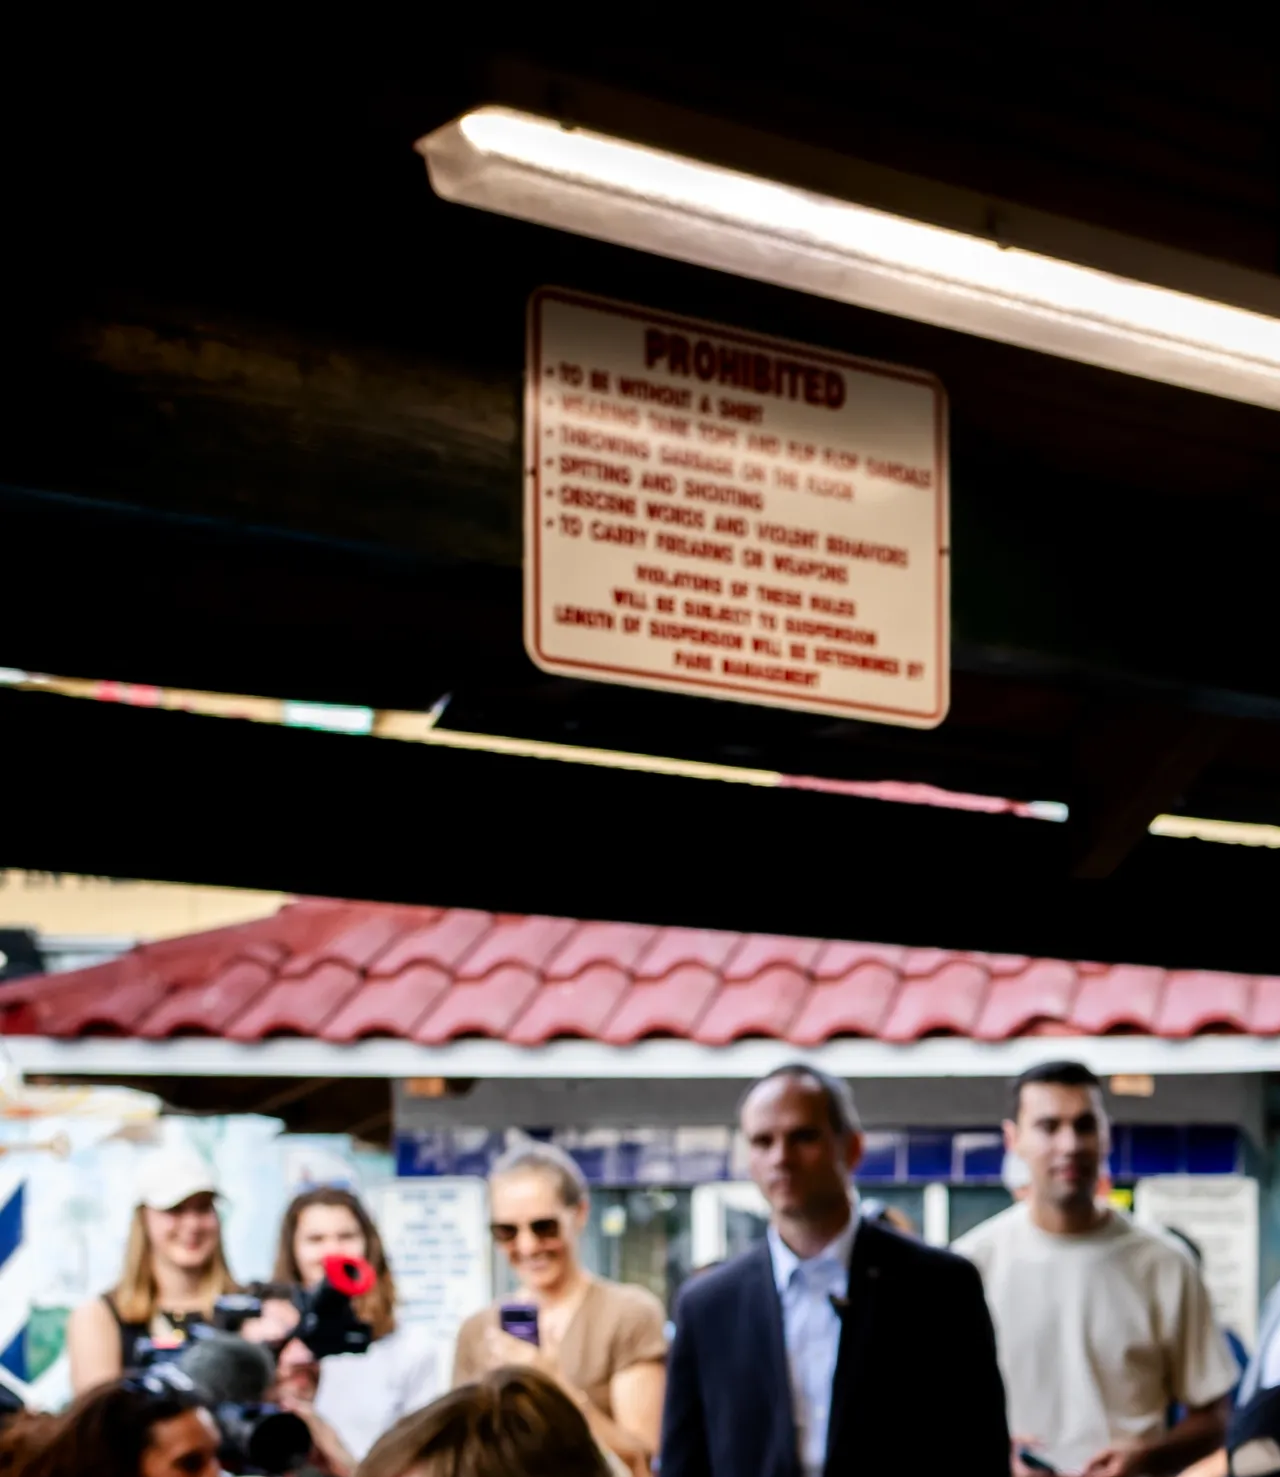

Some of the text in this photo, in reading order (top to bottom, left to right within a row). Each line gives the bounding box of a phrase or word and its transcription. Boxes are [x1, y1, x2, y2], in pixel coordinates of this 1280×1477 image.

[559, 363, 581, 387] TO
[590, 370, 608, 392] BE
[619, 376, 690, 410] WITHOUT
[701, 394, 710, 414] A
[645, 329, 845, 411] PROHIBITED
[561, 426, 649, 461] THROWING
[560, 456, 630, 487] SPITTING
[640, 471, 675, 495] AND
[561, 484, 635, 517] OBSCENE
[646, 501, 703, 529] WORDS
[714, 513, 747, 537] AND
[758, 522, 817, 550] VIOLENT
[560, 515, 848, 585] TO CARRY FIREARMS OR WEAPONS
[636, 565, 721, 595] VIOLATORS
[730, 582, 747, 599] OF
[811, 596, 854, 617] RULES
[612, 589, 647, 609] WILL
[656, 596, 673, 614] BE
[786, 618, 876, 647] SUSPENSION
[623, 615, 639, 635] OF
[649, 619, 742, 651] SUSPENSION
[752, 636, 779, 657] WILL
